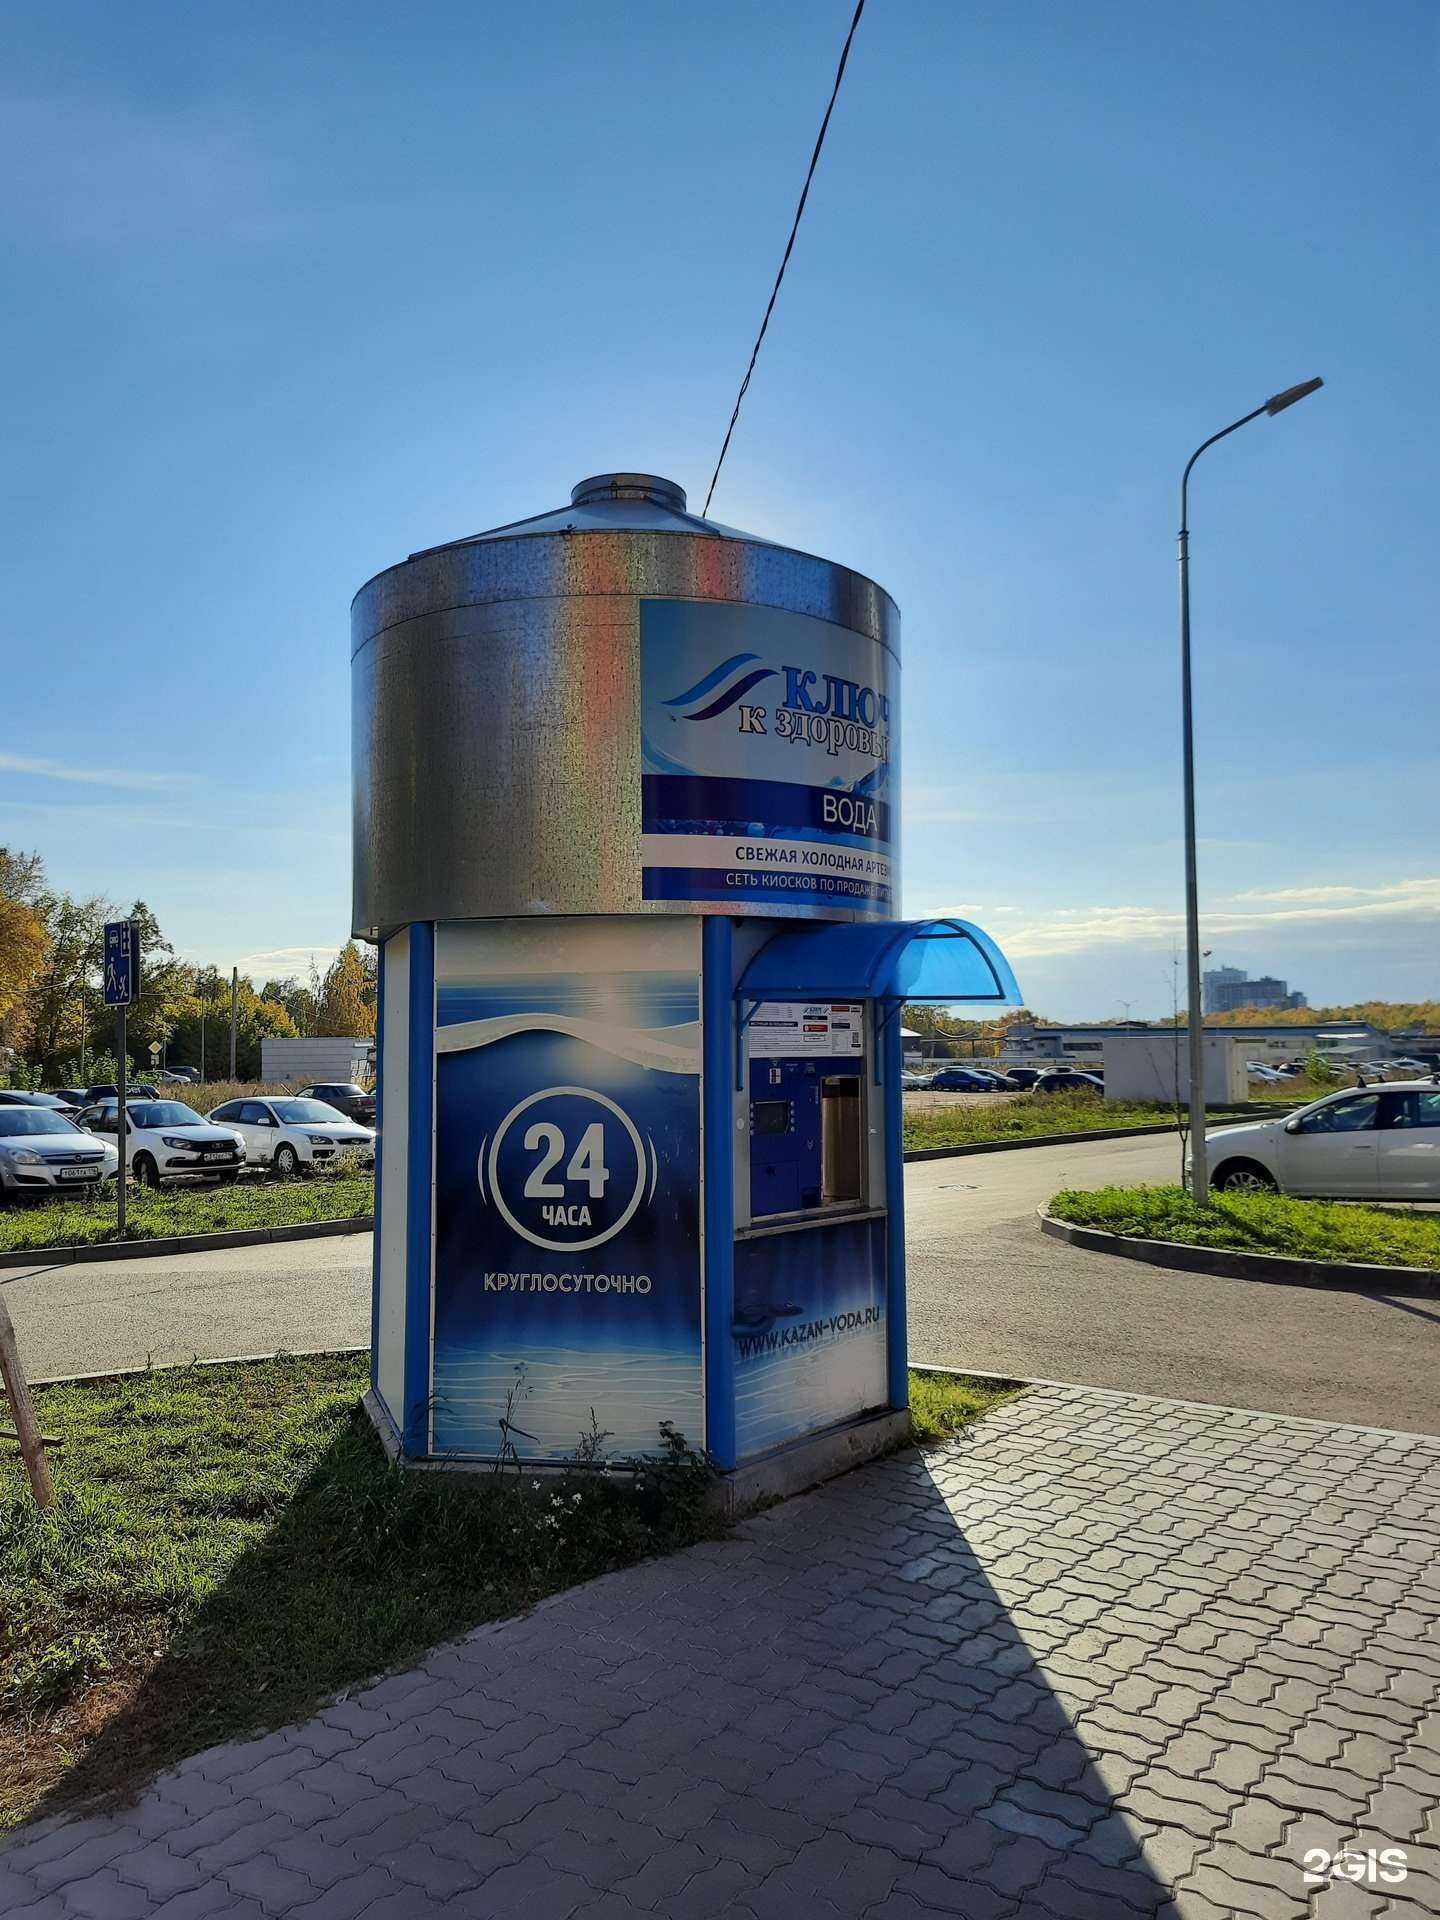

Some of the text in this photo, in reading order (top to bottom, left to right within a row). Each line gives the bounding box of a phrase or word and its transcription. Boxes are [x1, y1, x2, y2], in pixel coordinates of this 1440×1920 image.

[823, 794, 879, 835] ВОДА
[735, 846, 797, 864] СВЕЖАЯ
[801, 850, 864, 872] ХОЛОДНАЯ
[725, 872, 758, 887] СЕТЬ
[761, 874, 818, 890] КИОСКОВ
[819, 877, 835, 892] ПО
[837, 880, 875, 897] ПРОДАЖЕ
[523, 1122, 610, 1199] 24
[541, 1206, 592, 1227] ЧАСА
[483, 1273, 653, 1294] КРУГЛОСУТОЧНО
[738, 1305, 881, 1360] WWW.KAZAN-VODA.RU
